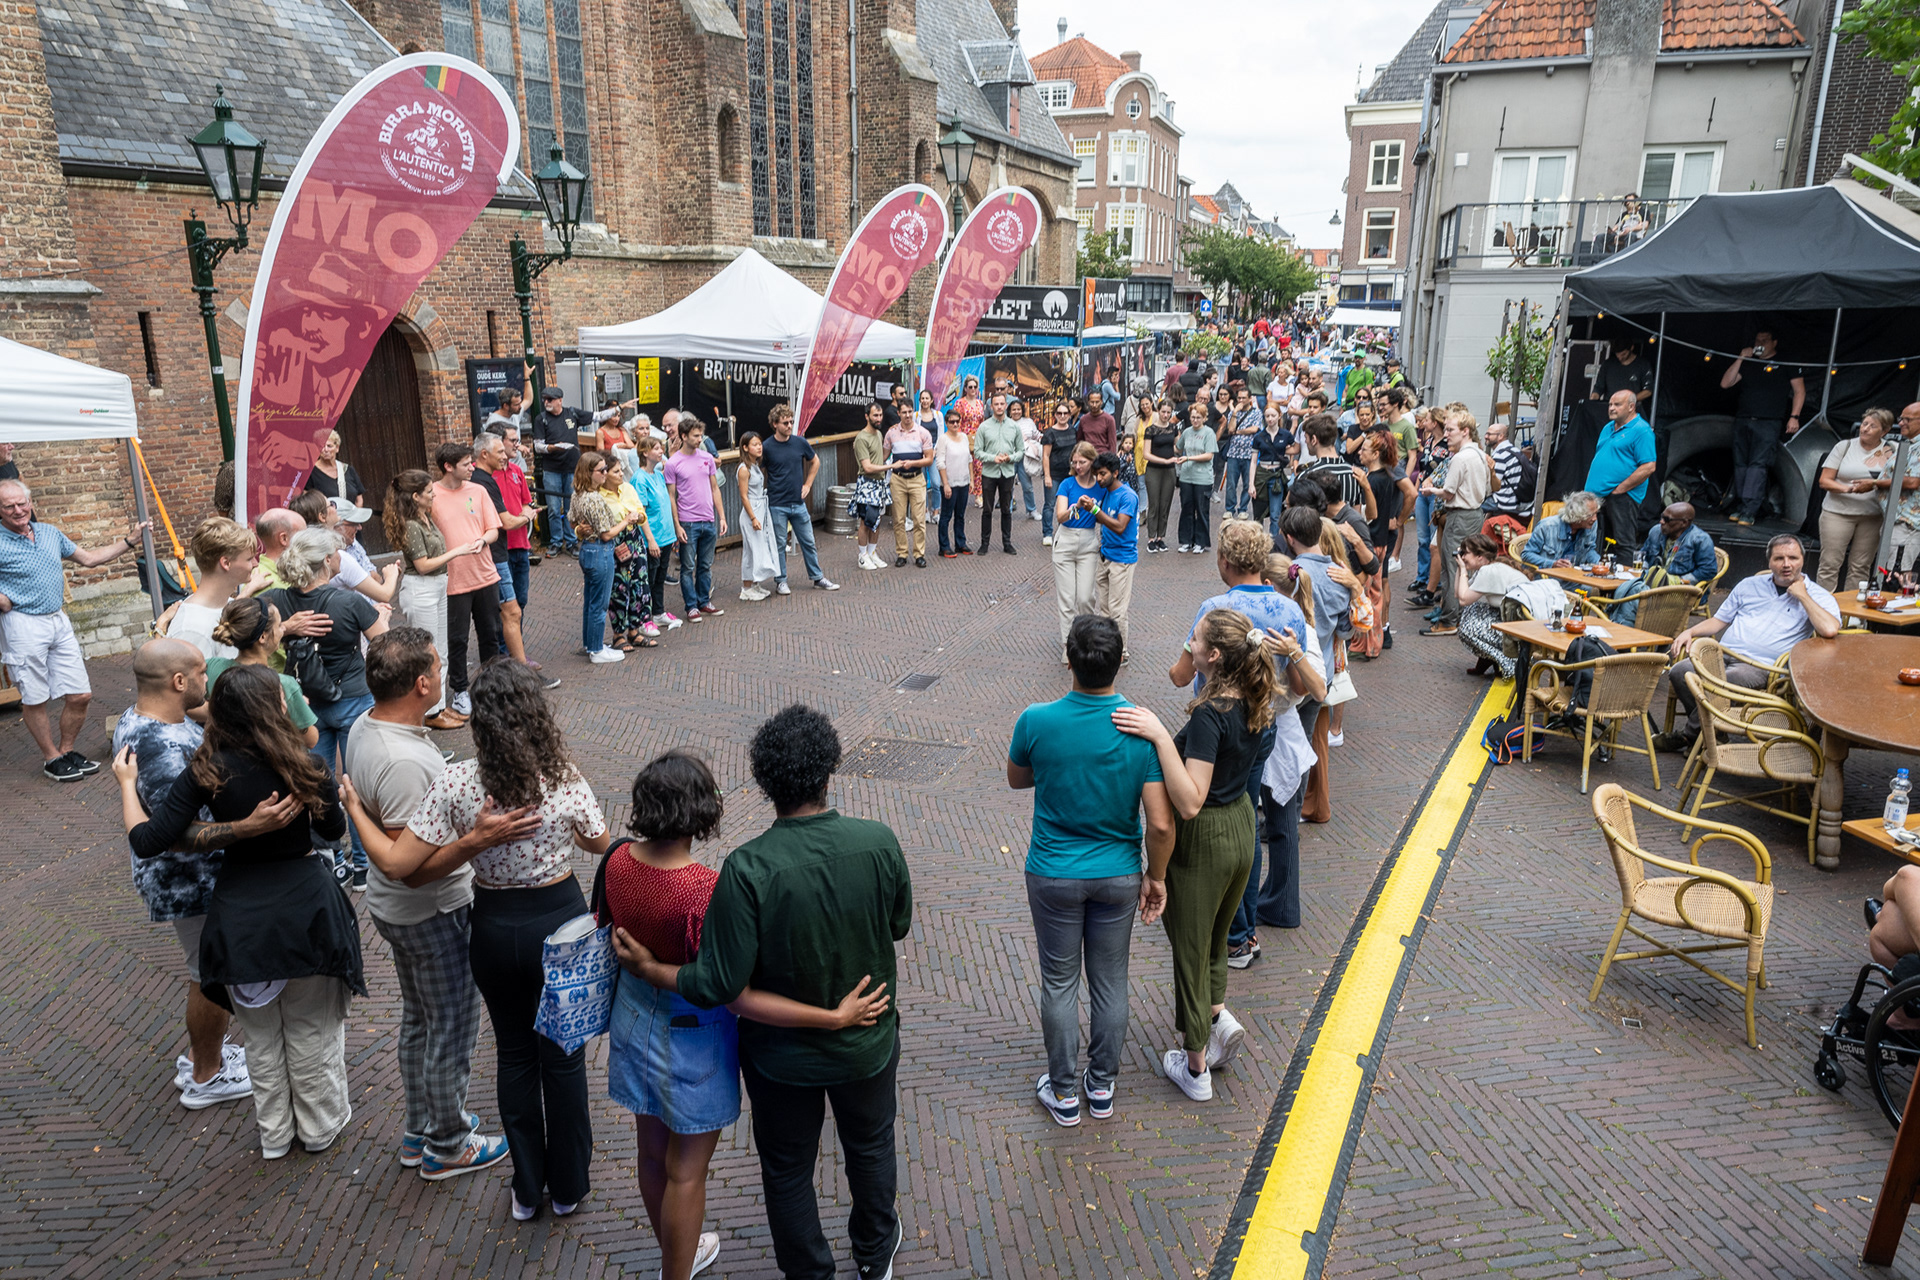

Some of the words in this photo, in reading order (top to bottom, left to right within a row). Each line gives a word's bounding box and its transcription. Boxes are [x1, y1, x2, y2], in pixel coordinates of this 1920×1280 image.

[378, 101, 425, 145] BIRRA
[427, 101, 475, 173] MORETTI
[393, 148, 455, 179] L'AUTENTICA
[408, 168, 420, 177] DAL
[421, 172, 436, 182] 1859
[398, 177, 422, 194] PREMIUM
[890, 209, 912, 230] BIRRA
[986, 209, 1005, 230] BIRRA
[1033, 319, 1076, 330] BROUWPLEIN
[476, 372, 491, 380] OUDE
[492, 371, 507, 379] KERK
[750, 384, 766, 395] CAFE
[766, 386, 775, 396] DE
[775, 387, 788, 398] OUD
[251, 401, 281, 421] Luigi
[1836, 1040, 1866, 1055] Activa
[1881, 1048, 1898, 1061] 2.5
